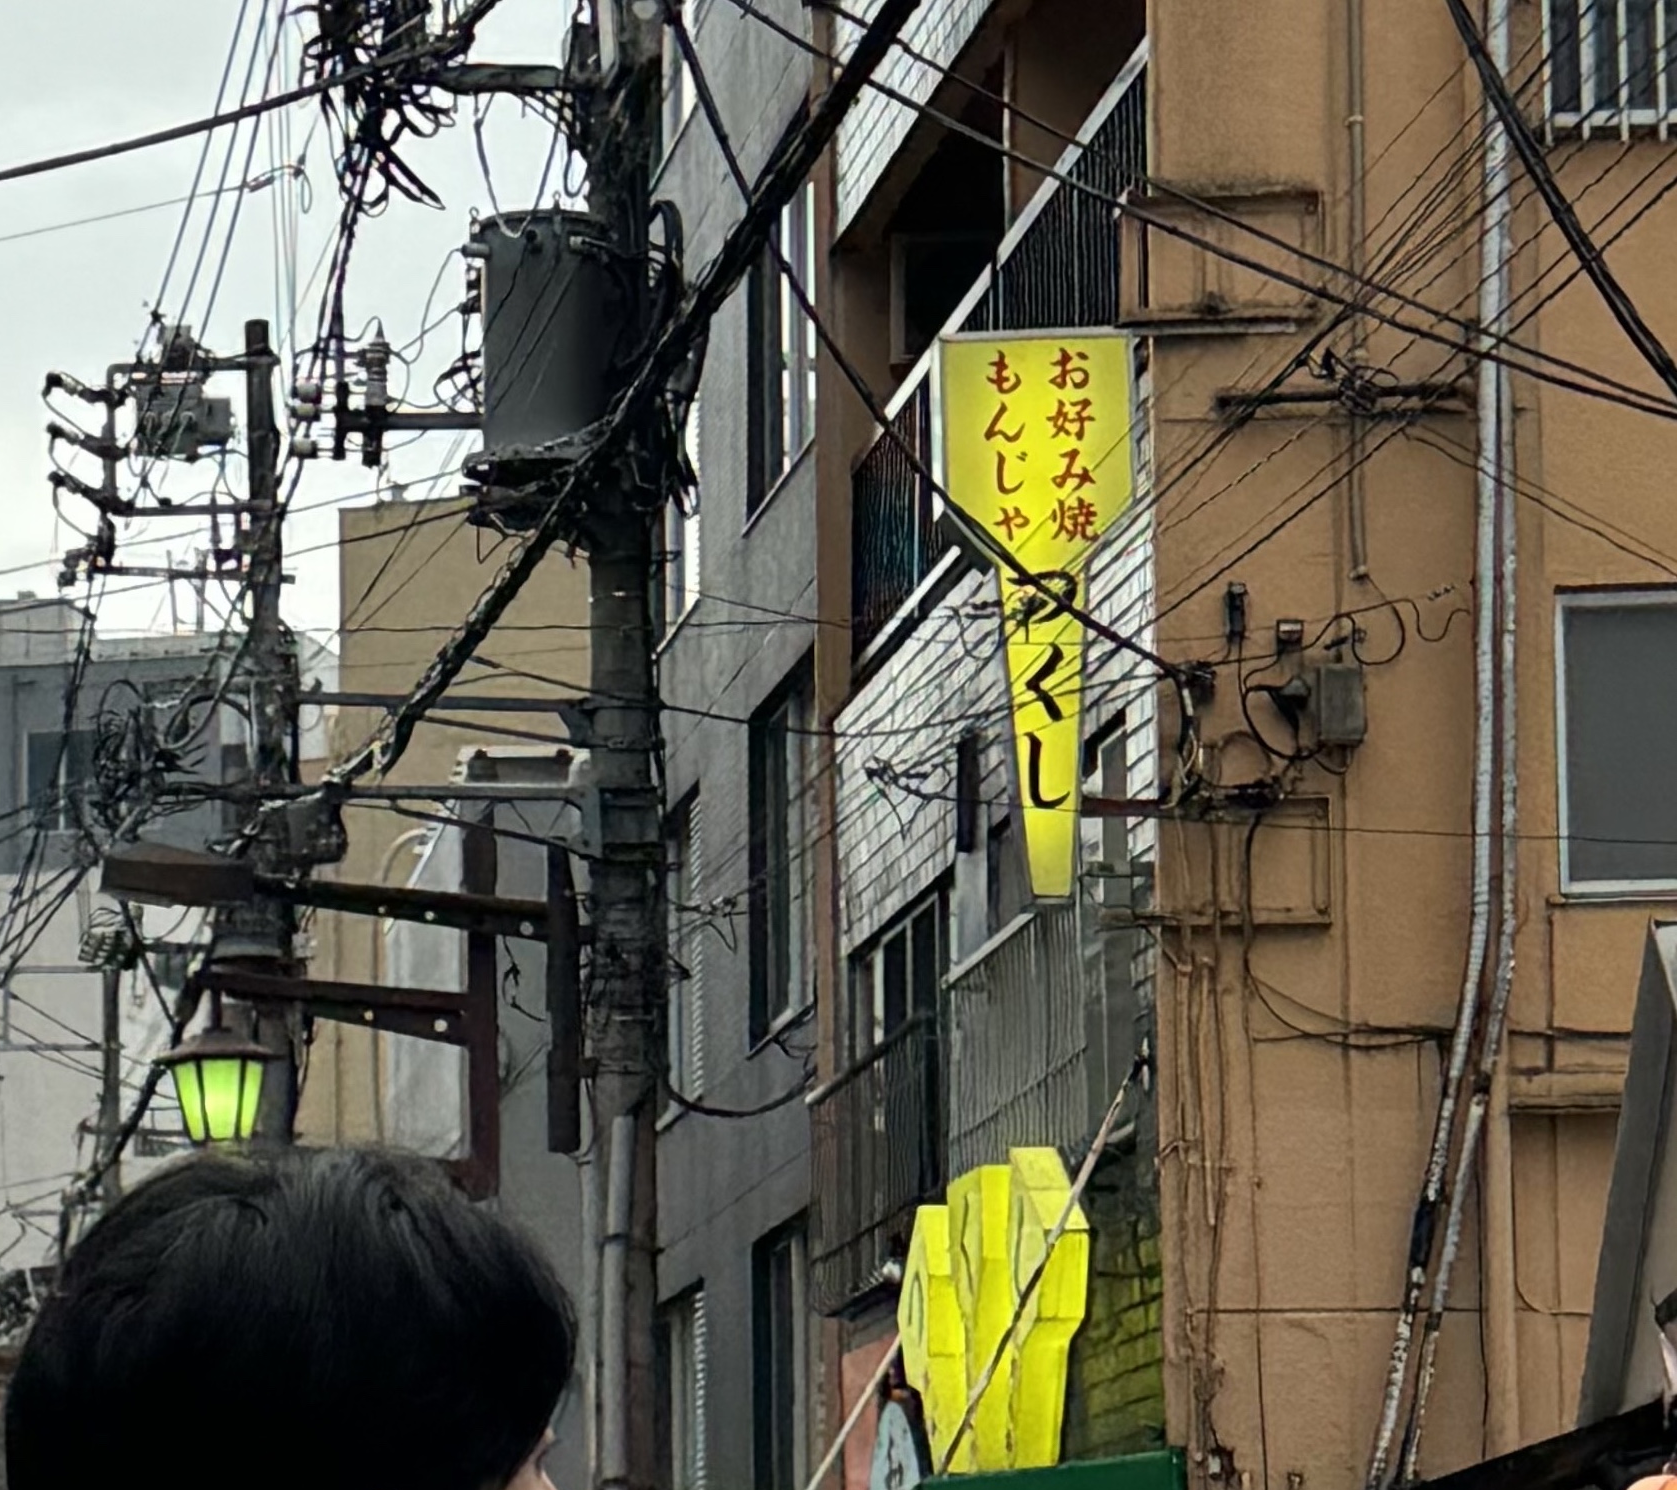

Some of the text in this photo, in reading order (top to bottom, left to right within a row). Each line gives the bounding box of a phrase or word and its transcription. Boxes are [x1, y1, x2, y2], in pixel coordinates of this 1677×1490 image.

[1046, 347, 1100, 543] お好み焼
[1006, 570, 1078, 809] つくし
